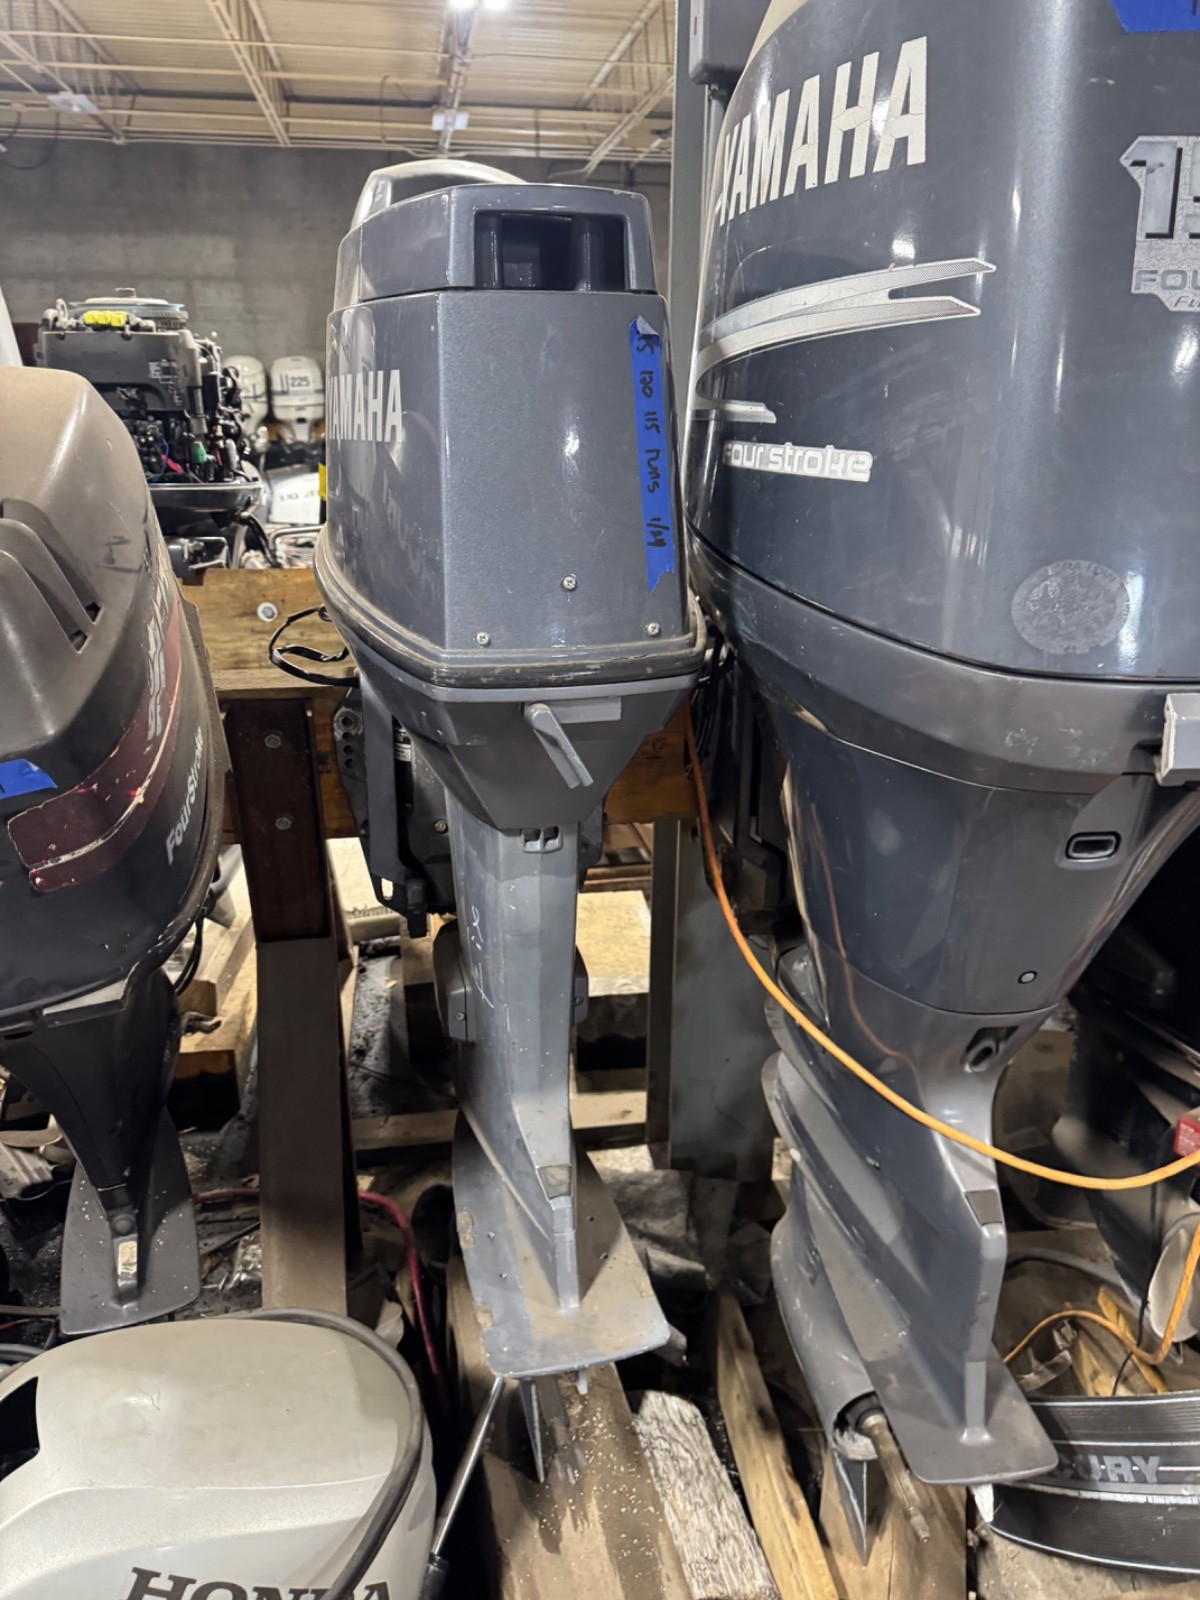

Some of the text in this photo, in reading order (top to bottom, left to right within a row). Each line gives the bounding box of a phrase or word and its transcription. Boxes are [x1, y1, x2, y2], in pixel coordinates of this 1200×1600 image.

[715, 36, 927, 227] YAMAHA
[644, 411, 660, 434] 115
[125, 1566, 392, 1600] HOA
